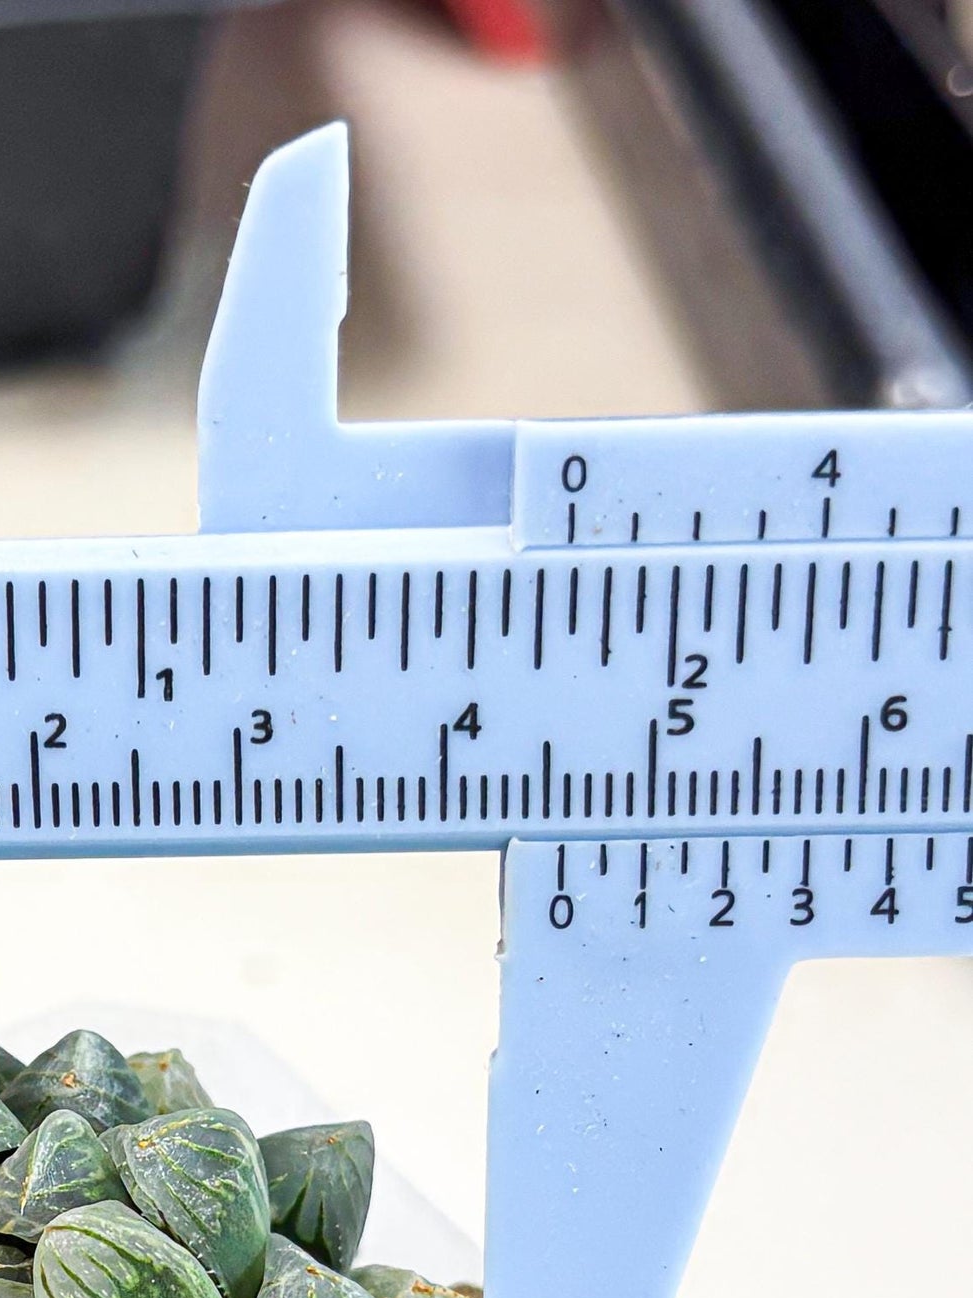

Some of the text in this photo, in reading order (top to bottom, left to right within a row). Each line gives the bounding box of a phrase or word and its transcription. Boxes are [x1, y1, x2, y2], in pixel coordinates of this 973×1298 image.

[561, 449, 842, 493] 0 4
[155, 667, 174, 702] 1
[681, 653, 709, 690] 2
[43, 712, 67, 749] 2
[249, 709, 274, 745] 3
[452, 702, 483, 741] 4
[666, 698, 695, 736] 5
[879, 695, 908, 733] 6
[548, 885, 973, 930] 0 1 2 3 4 5
